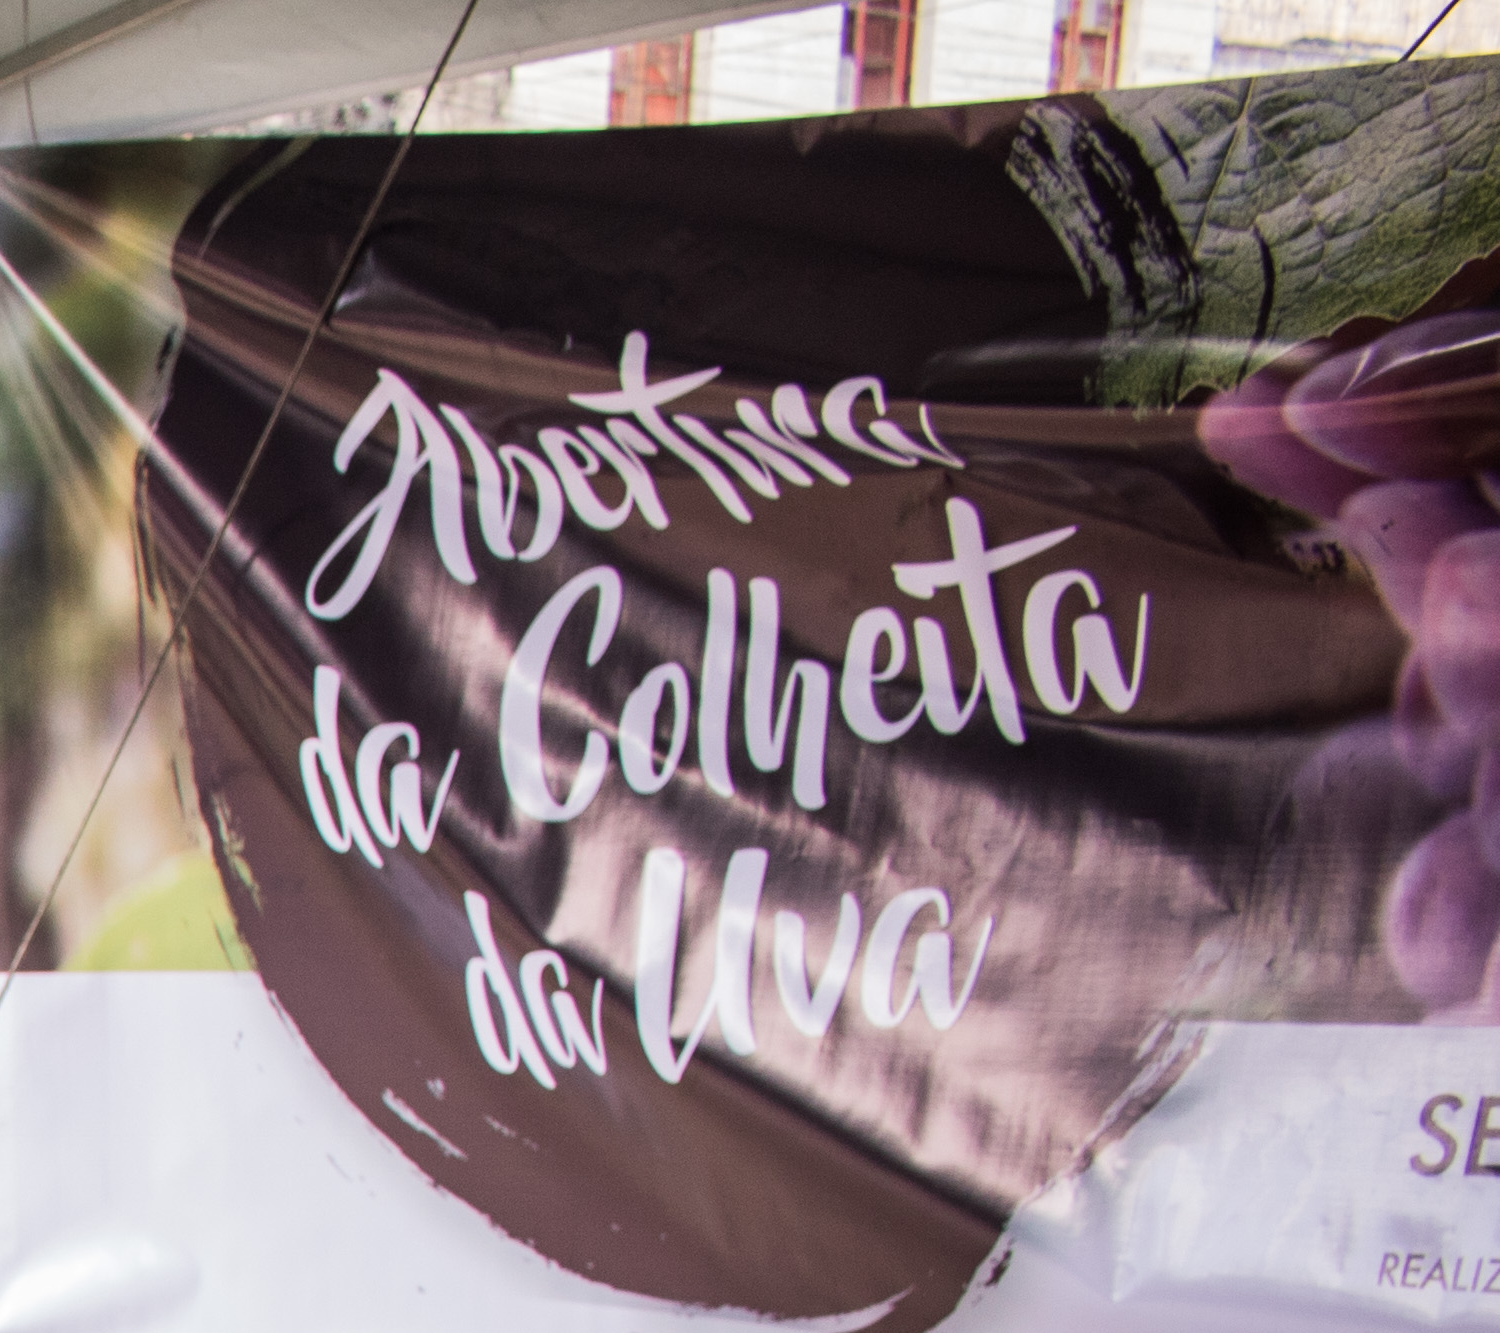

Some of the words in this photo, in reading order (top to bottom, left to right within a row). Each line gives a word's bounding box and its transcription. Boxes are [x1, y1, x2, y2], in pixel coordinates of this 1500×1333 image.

[305, 330, 965, 620] Abertura
[300, 665, 459, 869] da
[500, 497, 1148, 823] Colheita
[464, 891, 607, 1090] da
[635, 846, 992, 1083] Uva
[1409, 1093, 1500, 1177] SE
